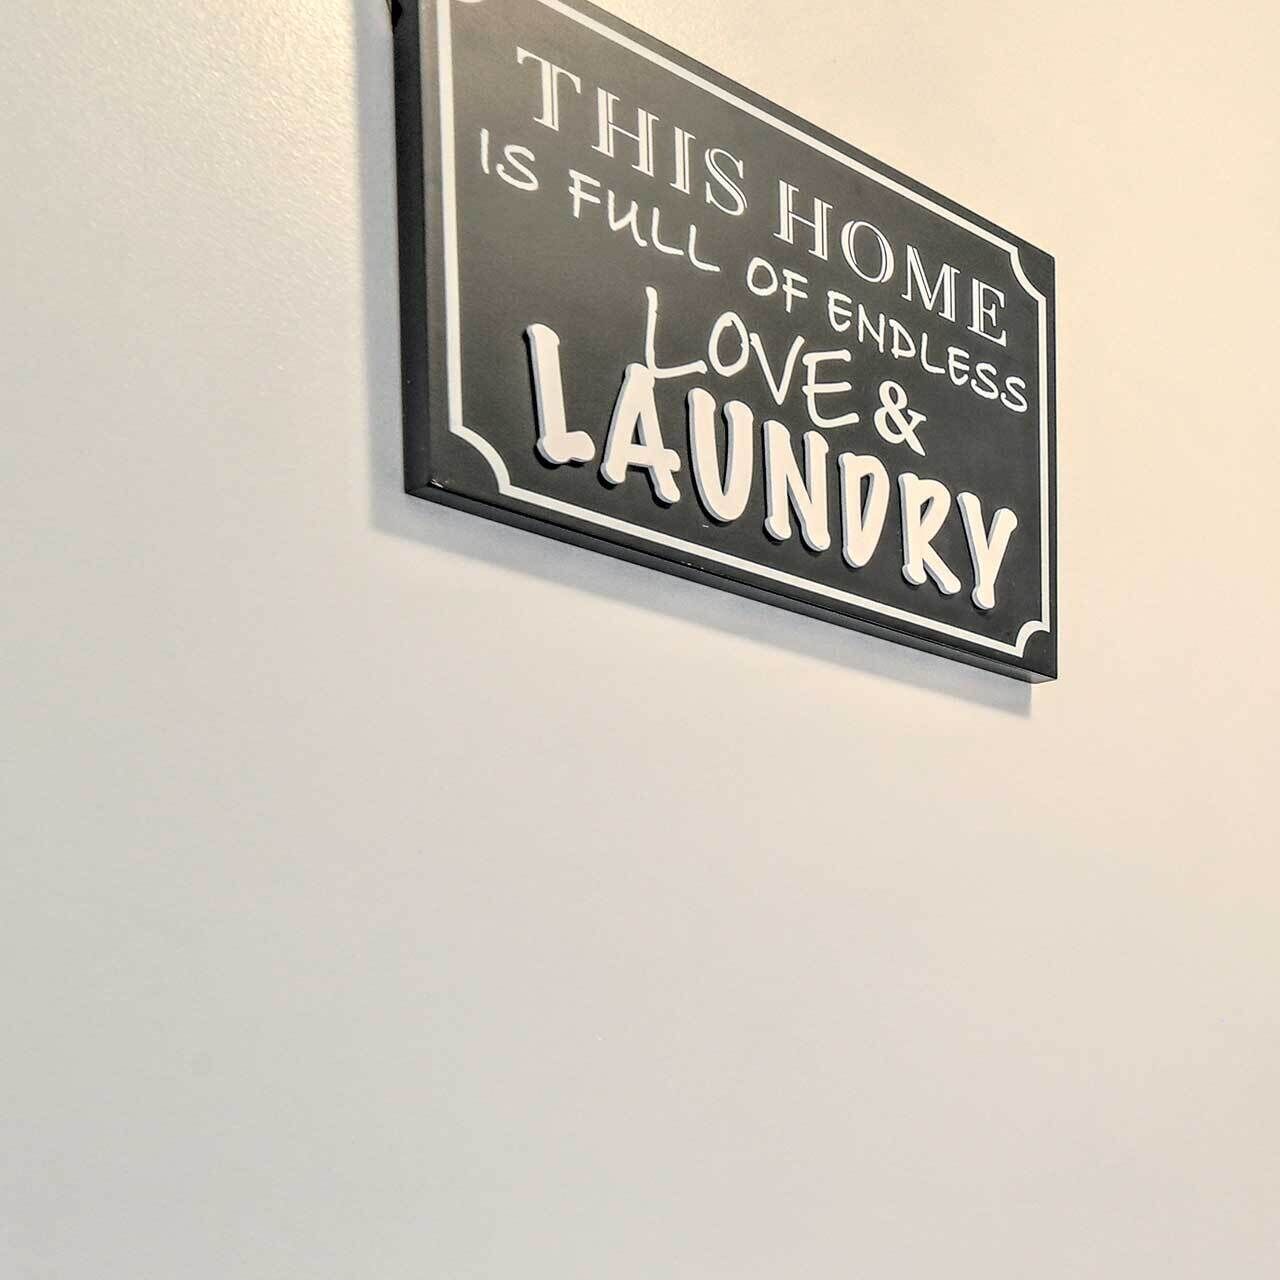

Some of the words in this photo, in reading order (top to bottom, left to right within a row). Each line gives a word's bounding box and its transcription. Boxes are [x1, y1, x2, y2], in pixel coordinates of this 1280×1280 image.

[479, 127, 539, 192] IS
[567, 168, 721, 272] FULL
[746, 256, 808, 313] OF
[827, 290, 1028, 413] ENDLESS
[516, 46, 748, 216] THIS
[773, 179, 1007, 347] HOME
[526, 322, 1018, 610] LAUNDRY
[645, 286, 861, 428] LOVE
[874, 380, 927, 456] &
